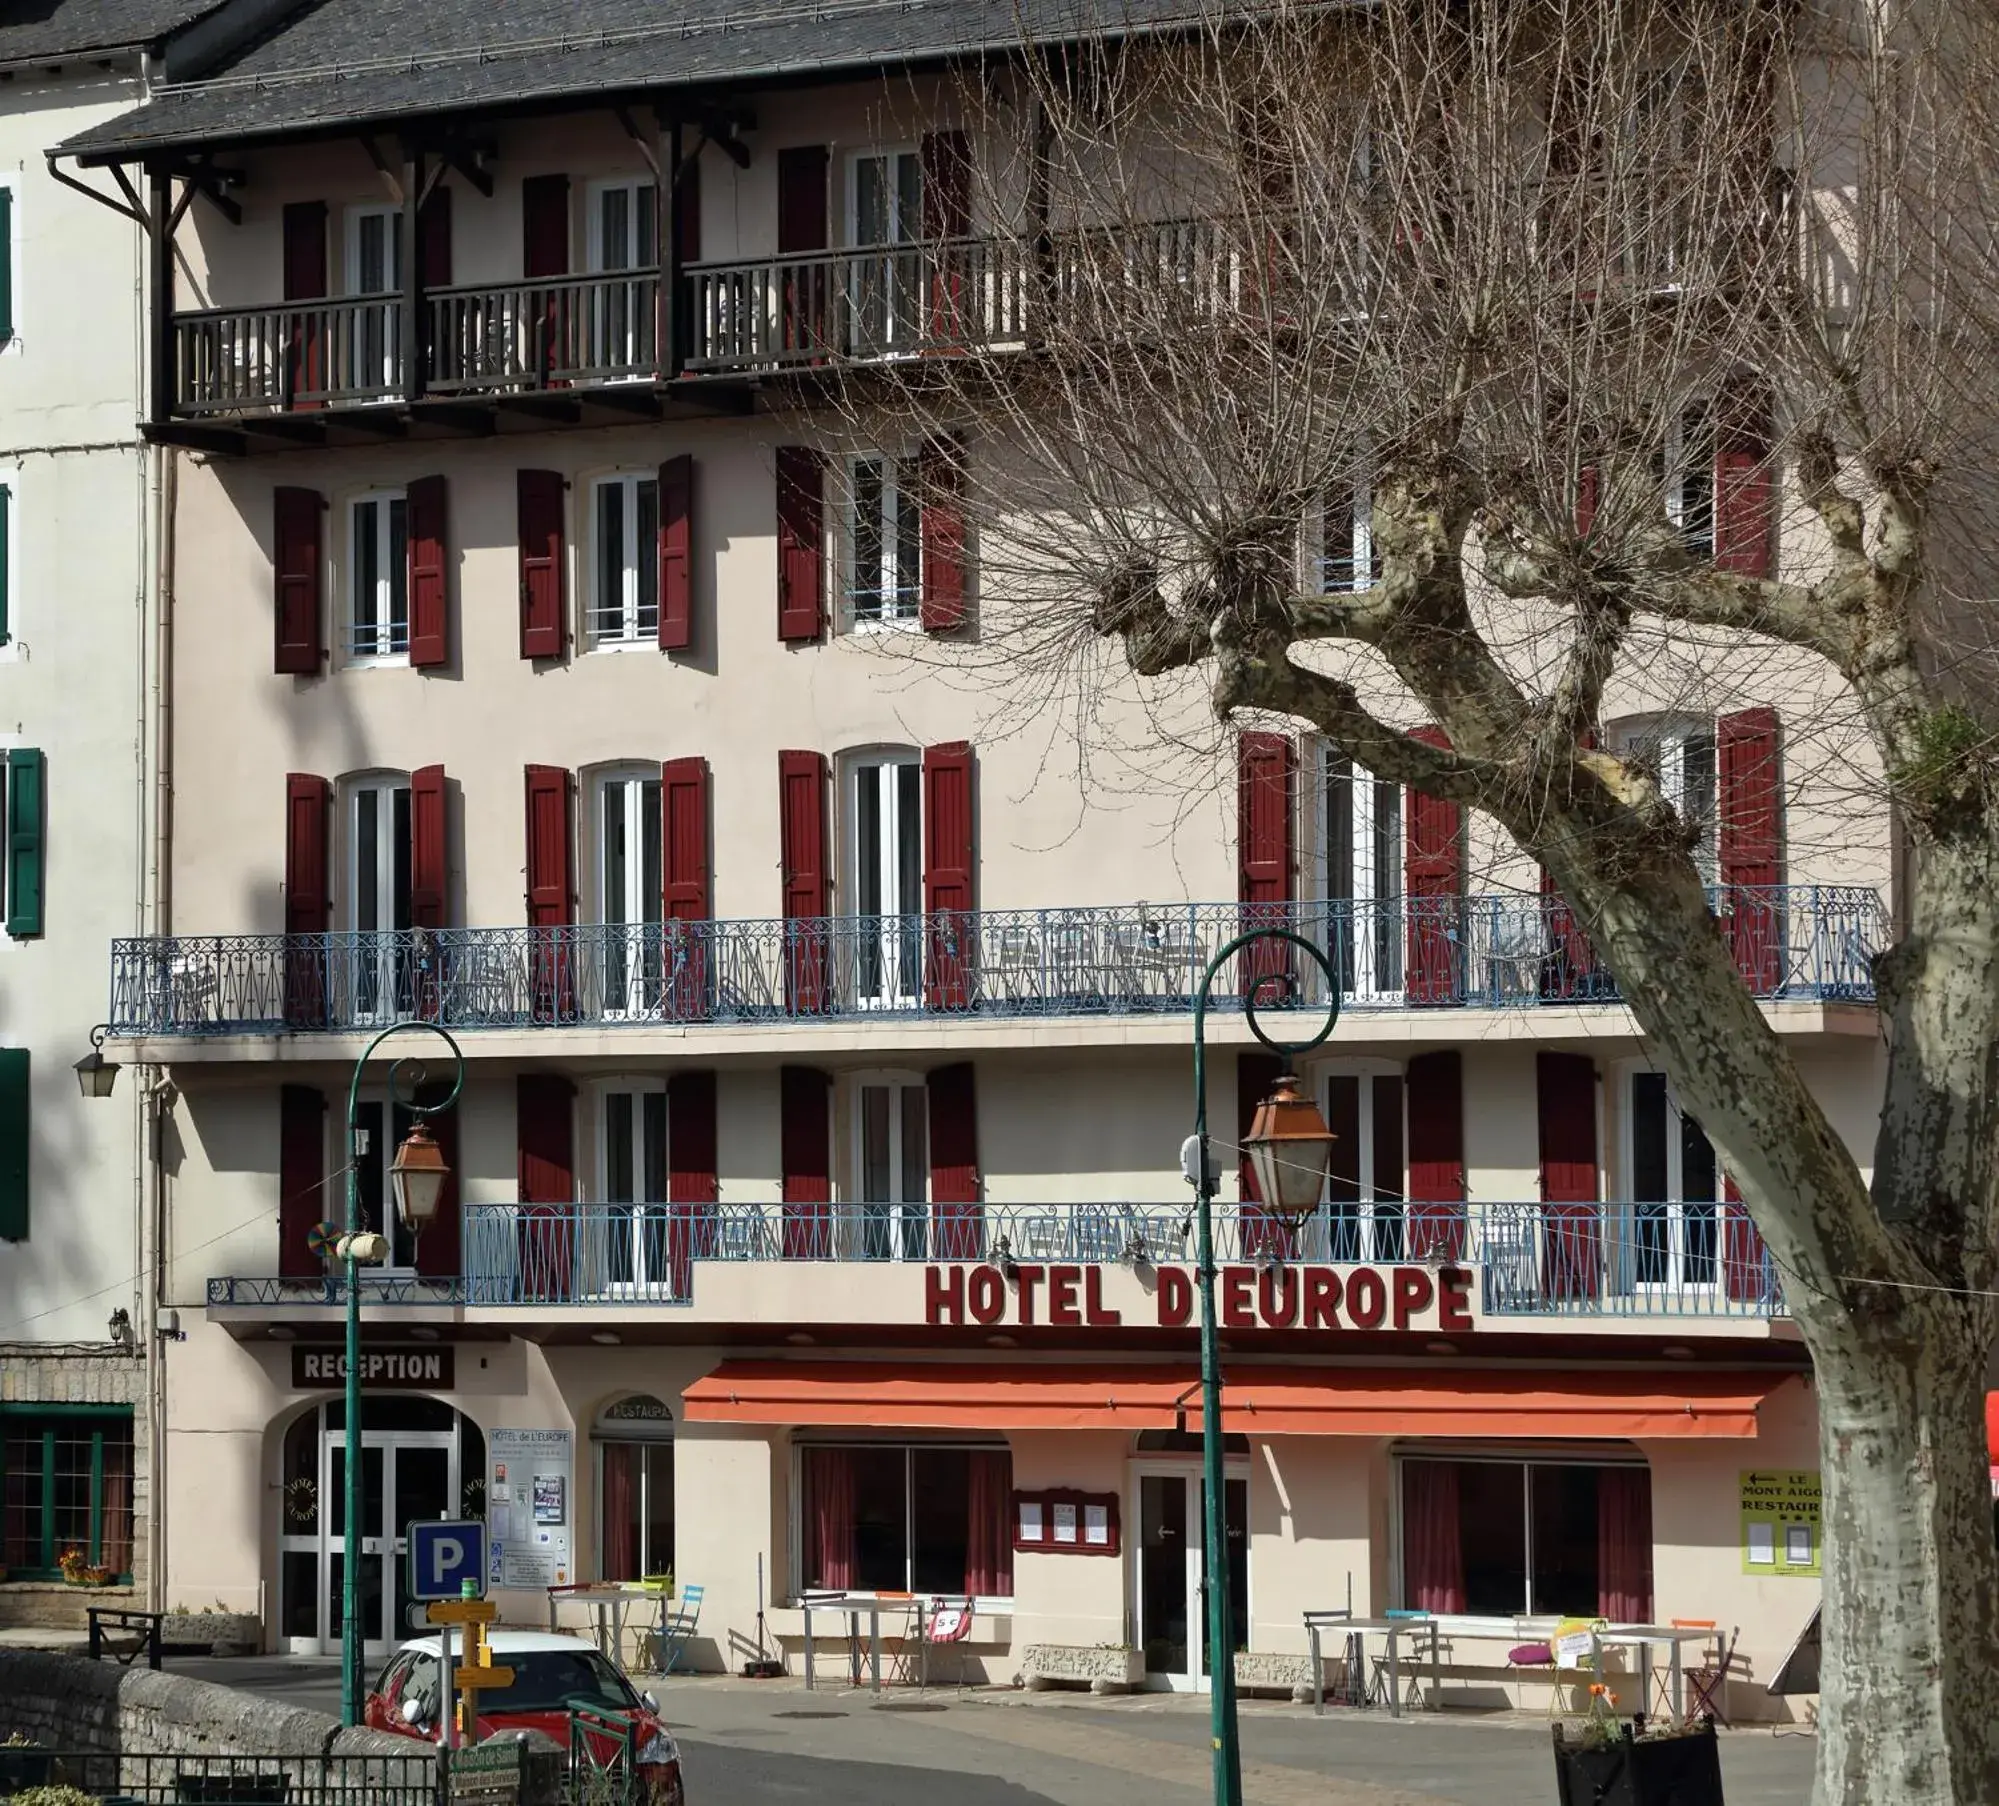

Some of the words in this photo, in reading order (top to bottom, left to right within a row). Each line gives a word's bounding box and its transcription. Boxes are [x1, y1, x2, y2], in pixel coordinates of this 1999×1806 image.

[925, 1265, 1121, 1327] HOTEL
[1742, 1486, 1783, 1496] MONT
[1788, 1475, 1807, 1484] LE
[433, 1537, 465, 1582] P
